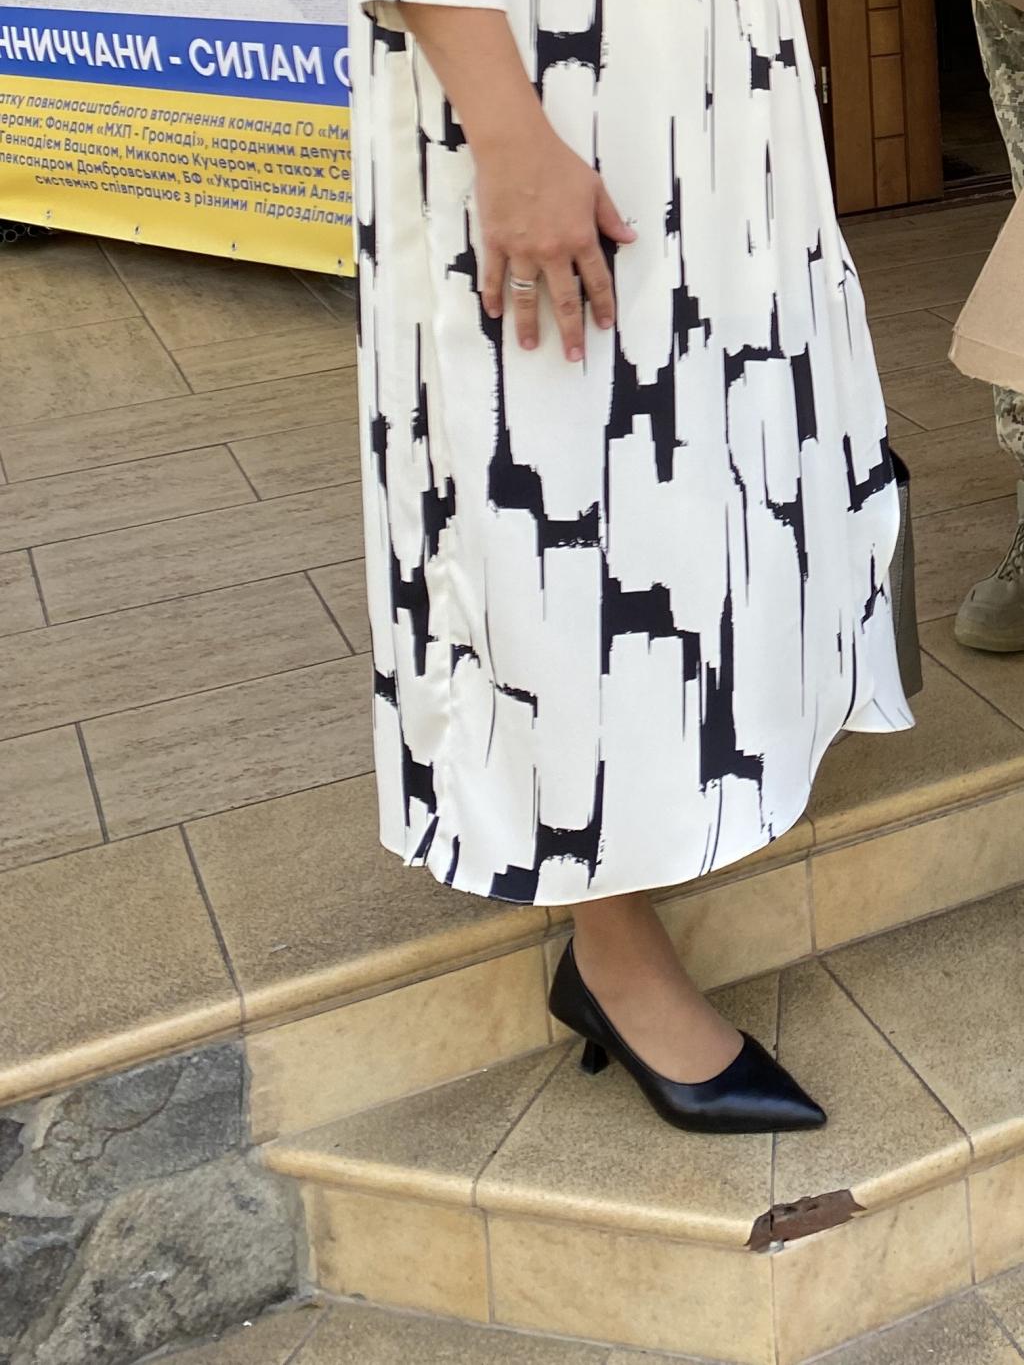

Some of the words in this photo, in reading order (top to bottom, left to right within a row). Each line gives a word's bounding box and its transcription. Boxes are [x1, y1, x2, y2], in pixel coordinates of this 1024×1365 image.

[188, 38, 325, 85] СИЛАМ
[0, 112, 43, 130] ерами:
[45, 116, 93, 134] Фондом
[97, 122, 132, 138] «МХП
[142, 126, 208, 150] Громаді»,
[212, 137, 295, 158] народними
[27, 95, 148, 118] повномасштабного
[150, 108, 225, 129] вторгнення
[228, 116, 292, 135] команда
[295, 120, 314, 137] ГО
[64, 138, 123, 160] Вацаком,
[126, 145, 189, 166] Миколою
[191, 153, 261, 175] Кучером,
[264, 163, 273, 174] а
[276, 164, 325, 179] також
[77, 159, 181, 184] Домбровським,
[183, 171, 202, 185] БФ
[206, 174, 306, 198] «Український
[35, 174, 98, 190] системно
[101, 180, 181, 202] співпрацює
[184, 192, 191, 204] з
[195, 190, 248, 212] різними
[254, 198, 352, 228] підрозділами
